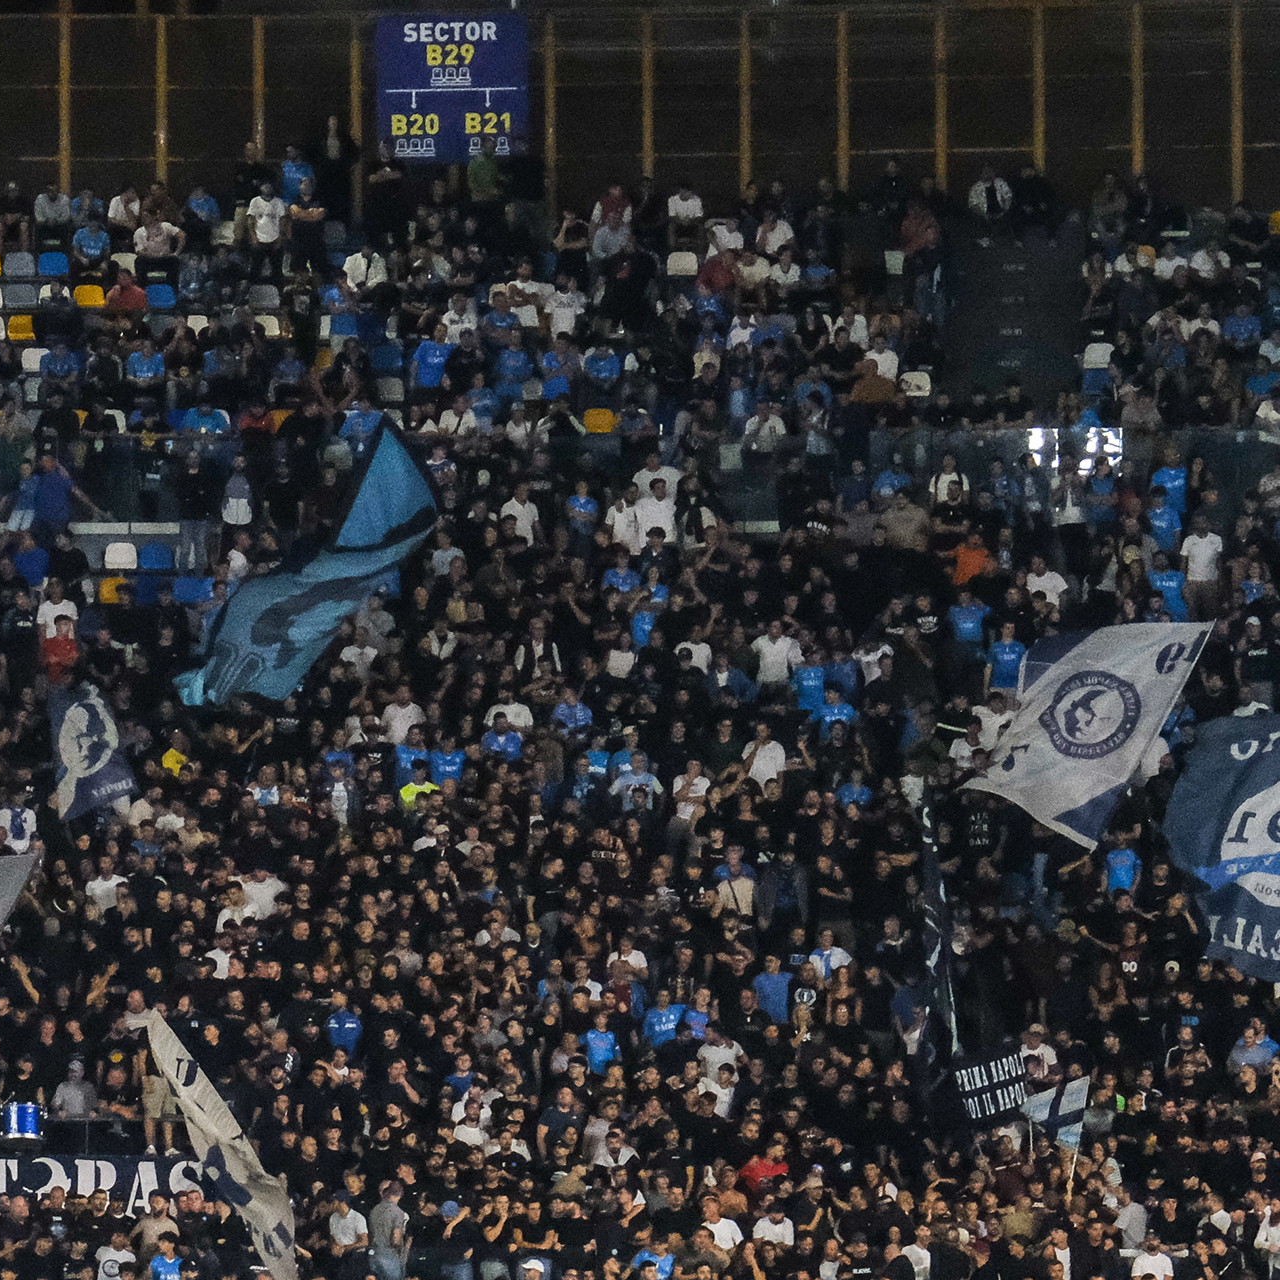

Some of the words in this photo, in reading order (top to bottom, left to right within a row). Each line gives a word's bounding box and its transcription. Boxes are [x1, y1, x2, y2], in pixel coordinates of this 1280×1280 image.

[403, 21, 497, 42] SECTOR
[426, 43, 475, 66] B29
[391, 113, 439, 136] B20
[465, 112, 511, 134] B21
[955, 1064, 989, 1092] PRIMA
[990, 1051, 1026, 1084] NAPOLI
